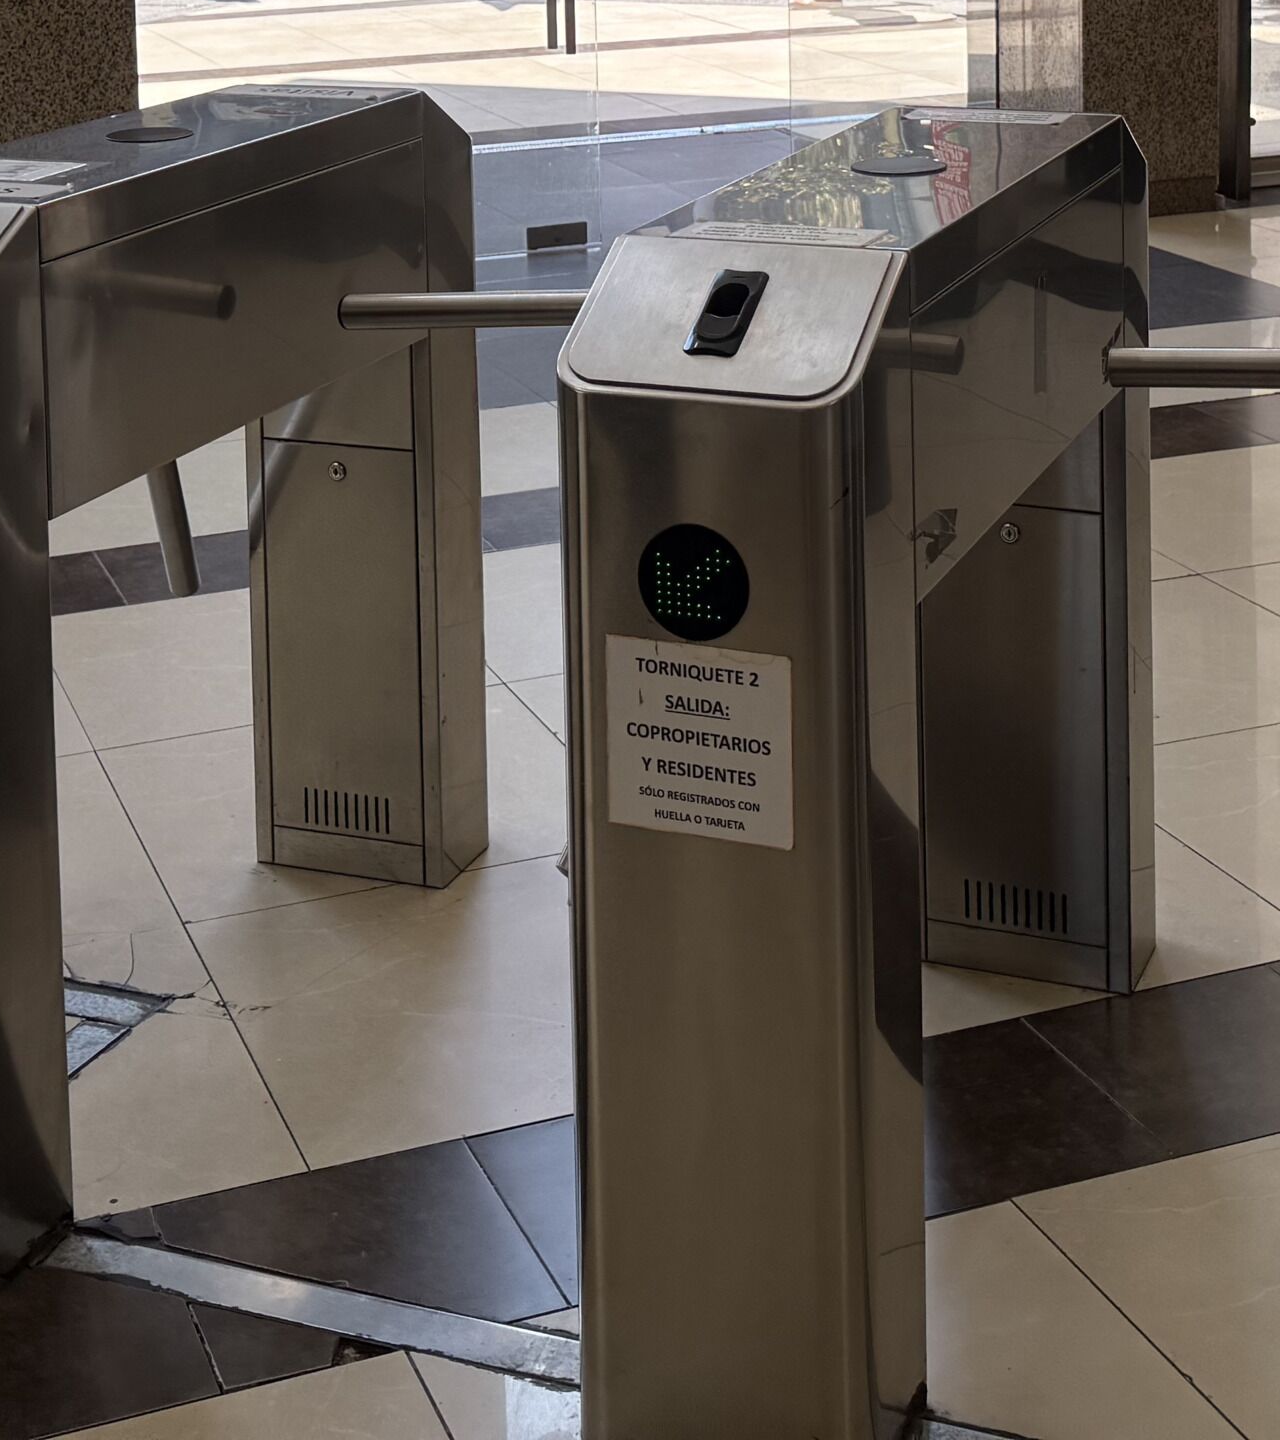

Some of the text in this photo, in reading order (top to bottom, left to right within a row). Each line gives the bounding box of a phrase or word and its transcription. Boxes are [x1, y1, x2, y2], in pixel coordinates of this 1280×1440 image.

[635, 657, 759, 687] TORNIQUETE 2
[665, 694, 730, 718] SALIDA:
[626, 721, 772, 756] COPROPIETARIOS
[641, 756, 757, 787] Y RESIDENTES
[639, 785, 760, 812] SÓLO REGISTRADOS CON
[654, 808, 746, 831] HUELLA O TARJETA
